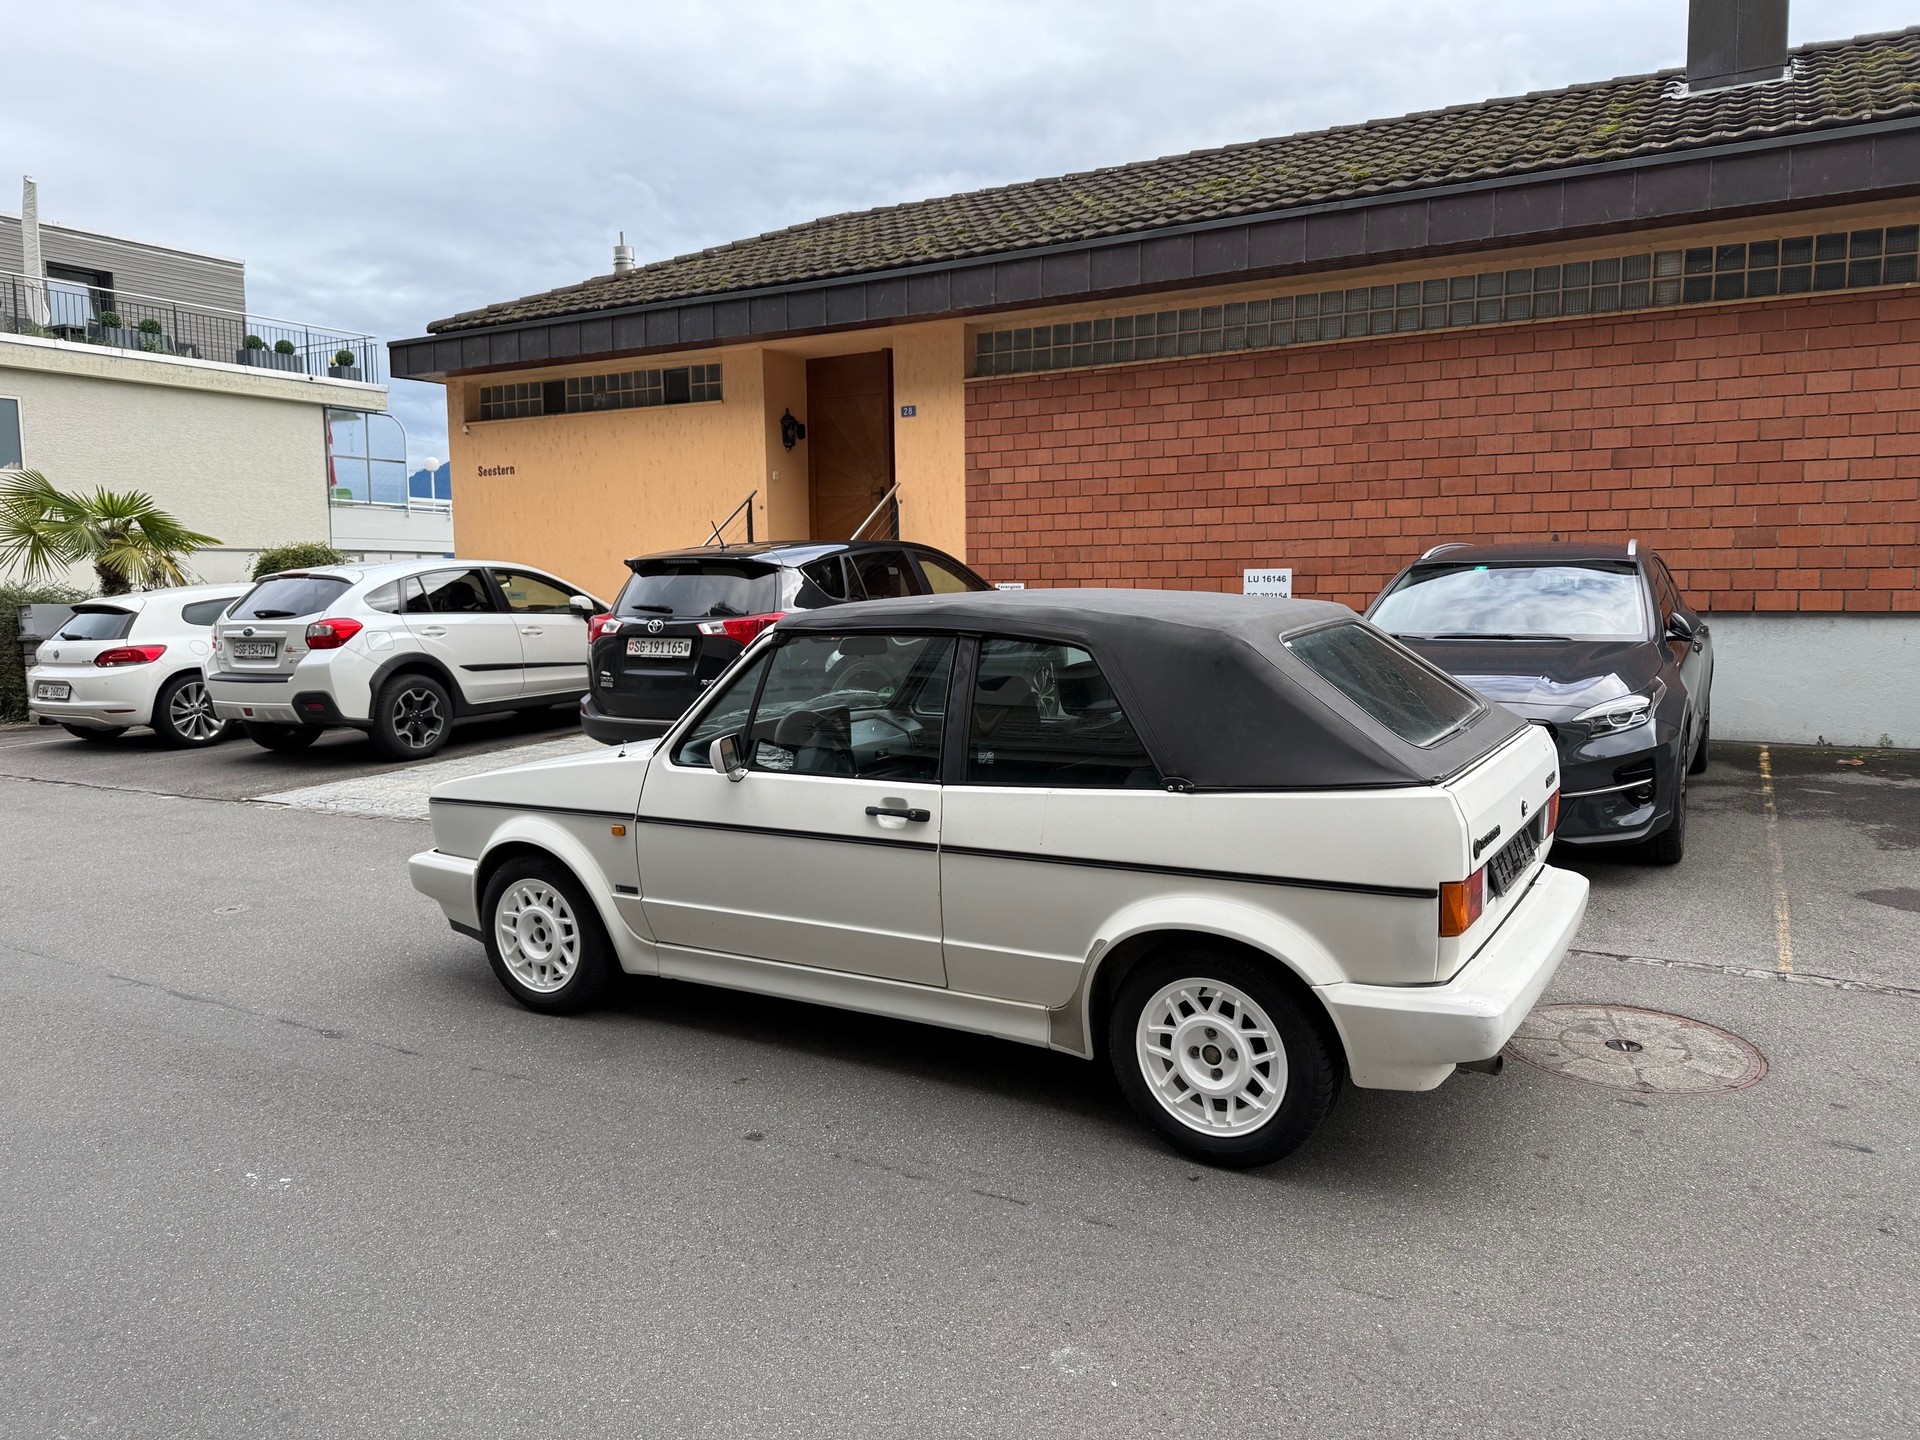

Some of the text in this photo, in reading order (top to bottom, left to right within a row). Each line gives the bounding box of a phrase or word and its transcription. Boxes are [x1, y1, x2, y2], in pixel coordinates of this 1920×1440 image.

[903, 407, 913, 416] 28
[478, 465, 515, 477] Seestern
[1247, 575, 1287, 583] LU 16146
